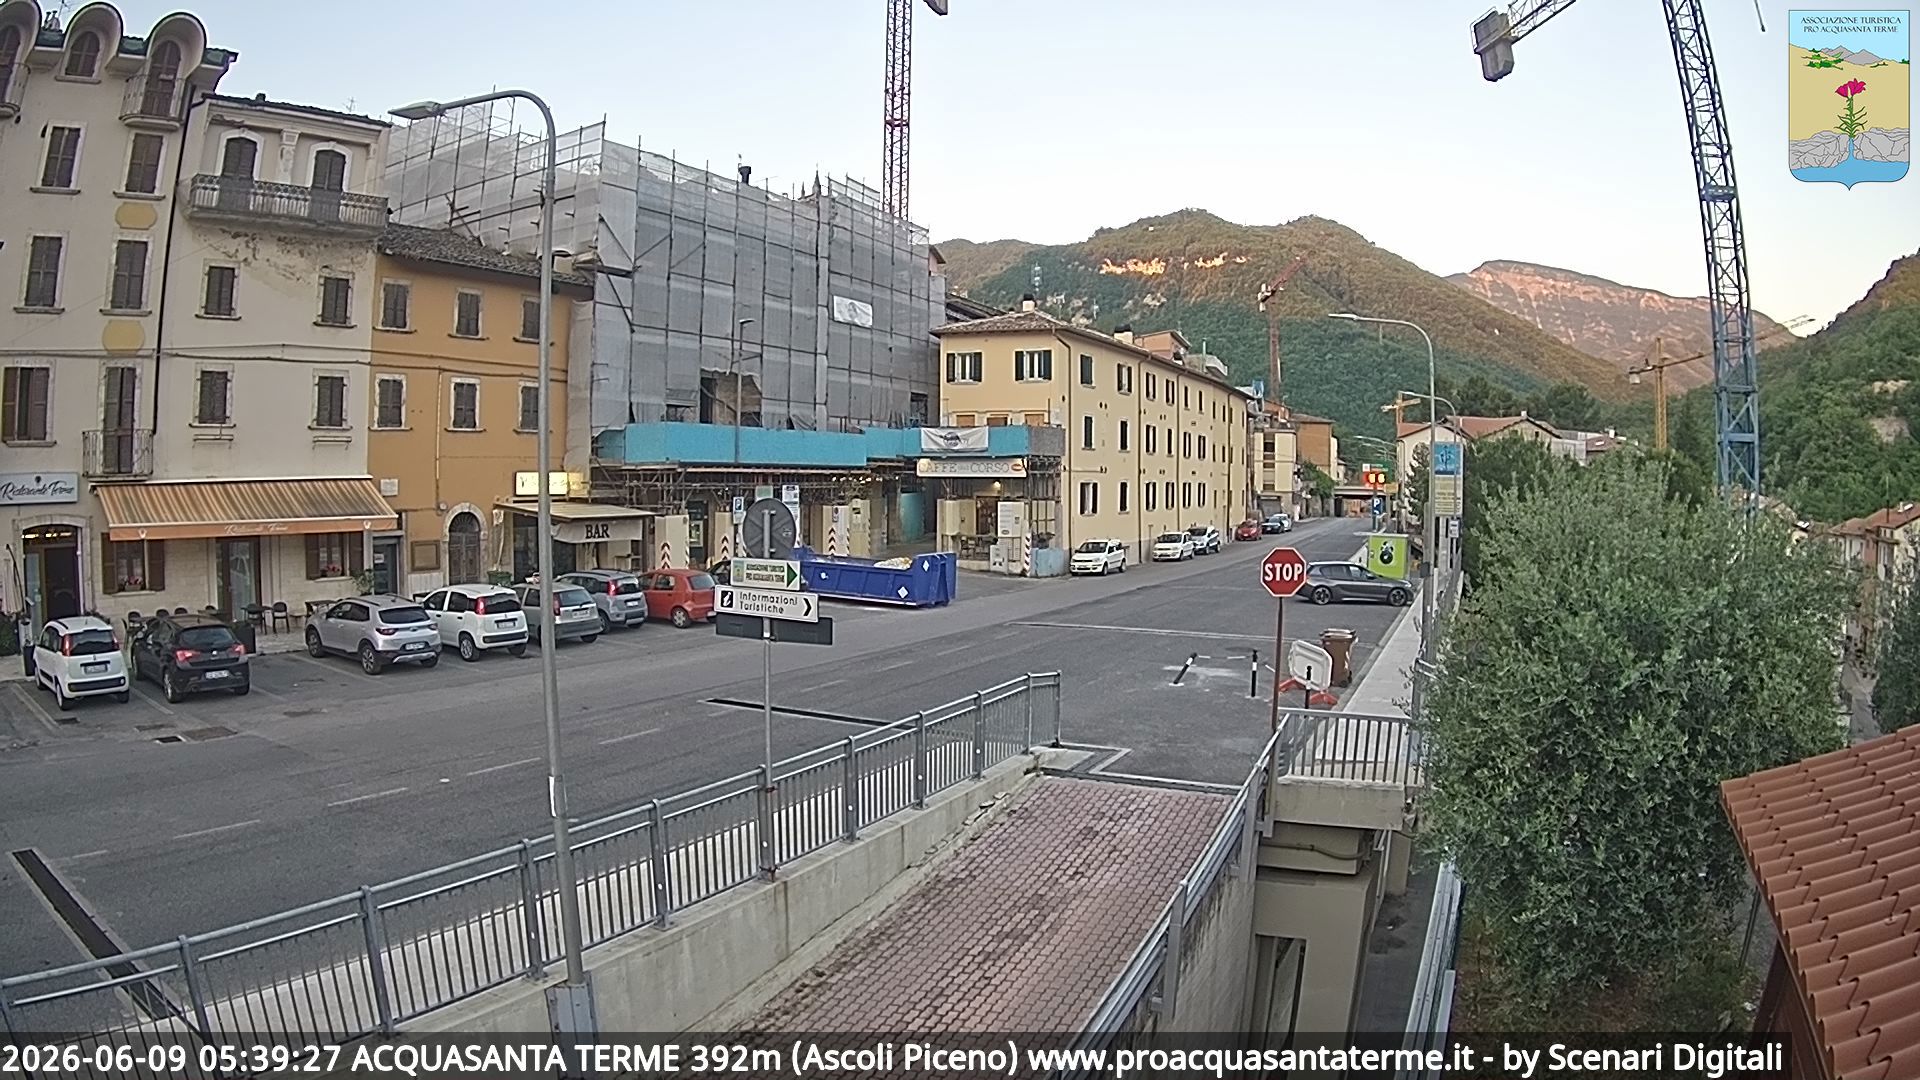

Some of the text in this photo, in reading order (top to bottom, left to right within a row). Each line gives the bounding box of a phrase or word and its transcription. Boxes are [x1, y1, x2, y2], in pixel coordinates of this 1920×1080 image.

[970, 462, 1010, 472] CORSO
[1373, 498, 1381, 508] P
[585, 523, 610, 539] BAR
[1264, 563, 1303, 582] STOP
[739, 592, 797, 605] Informazioni
[740, 601, 784, 614] Turistiche
